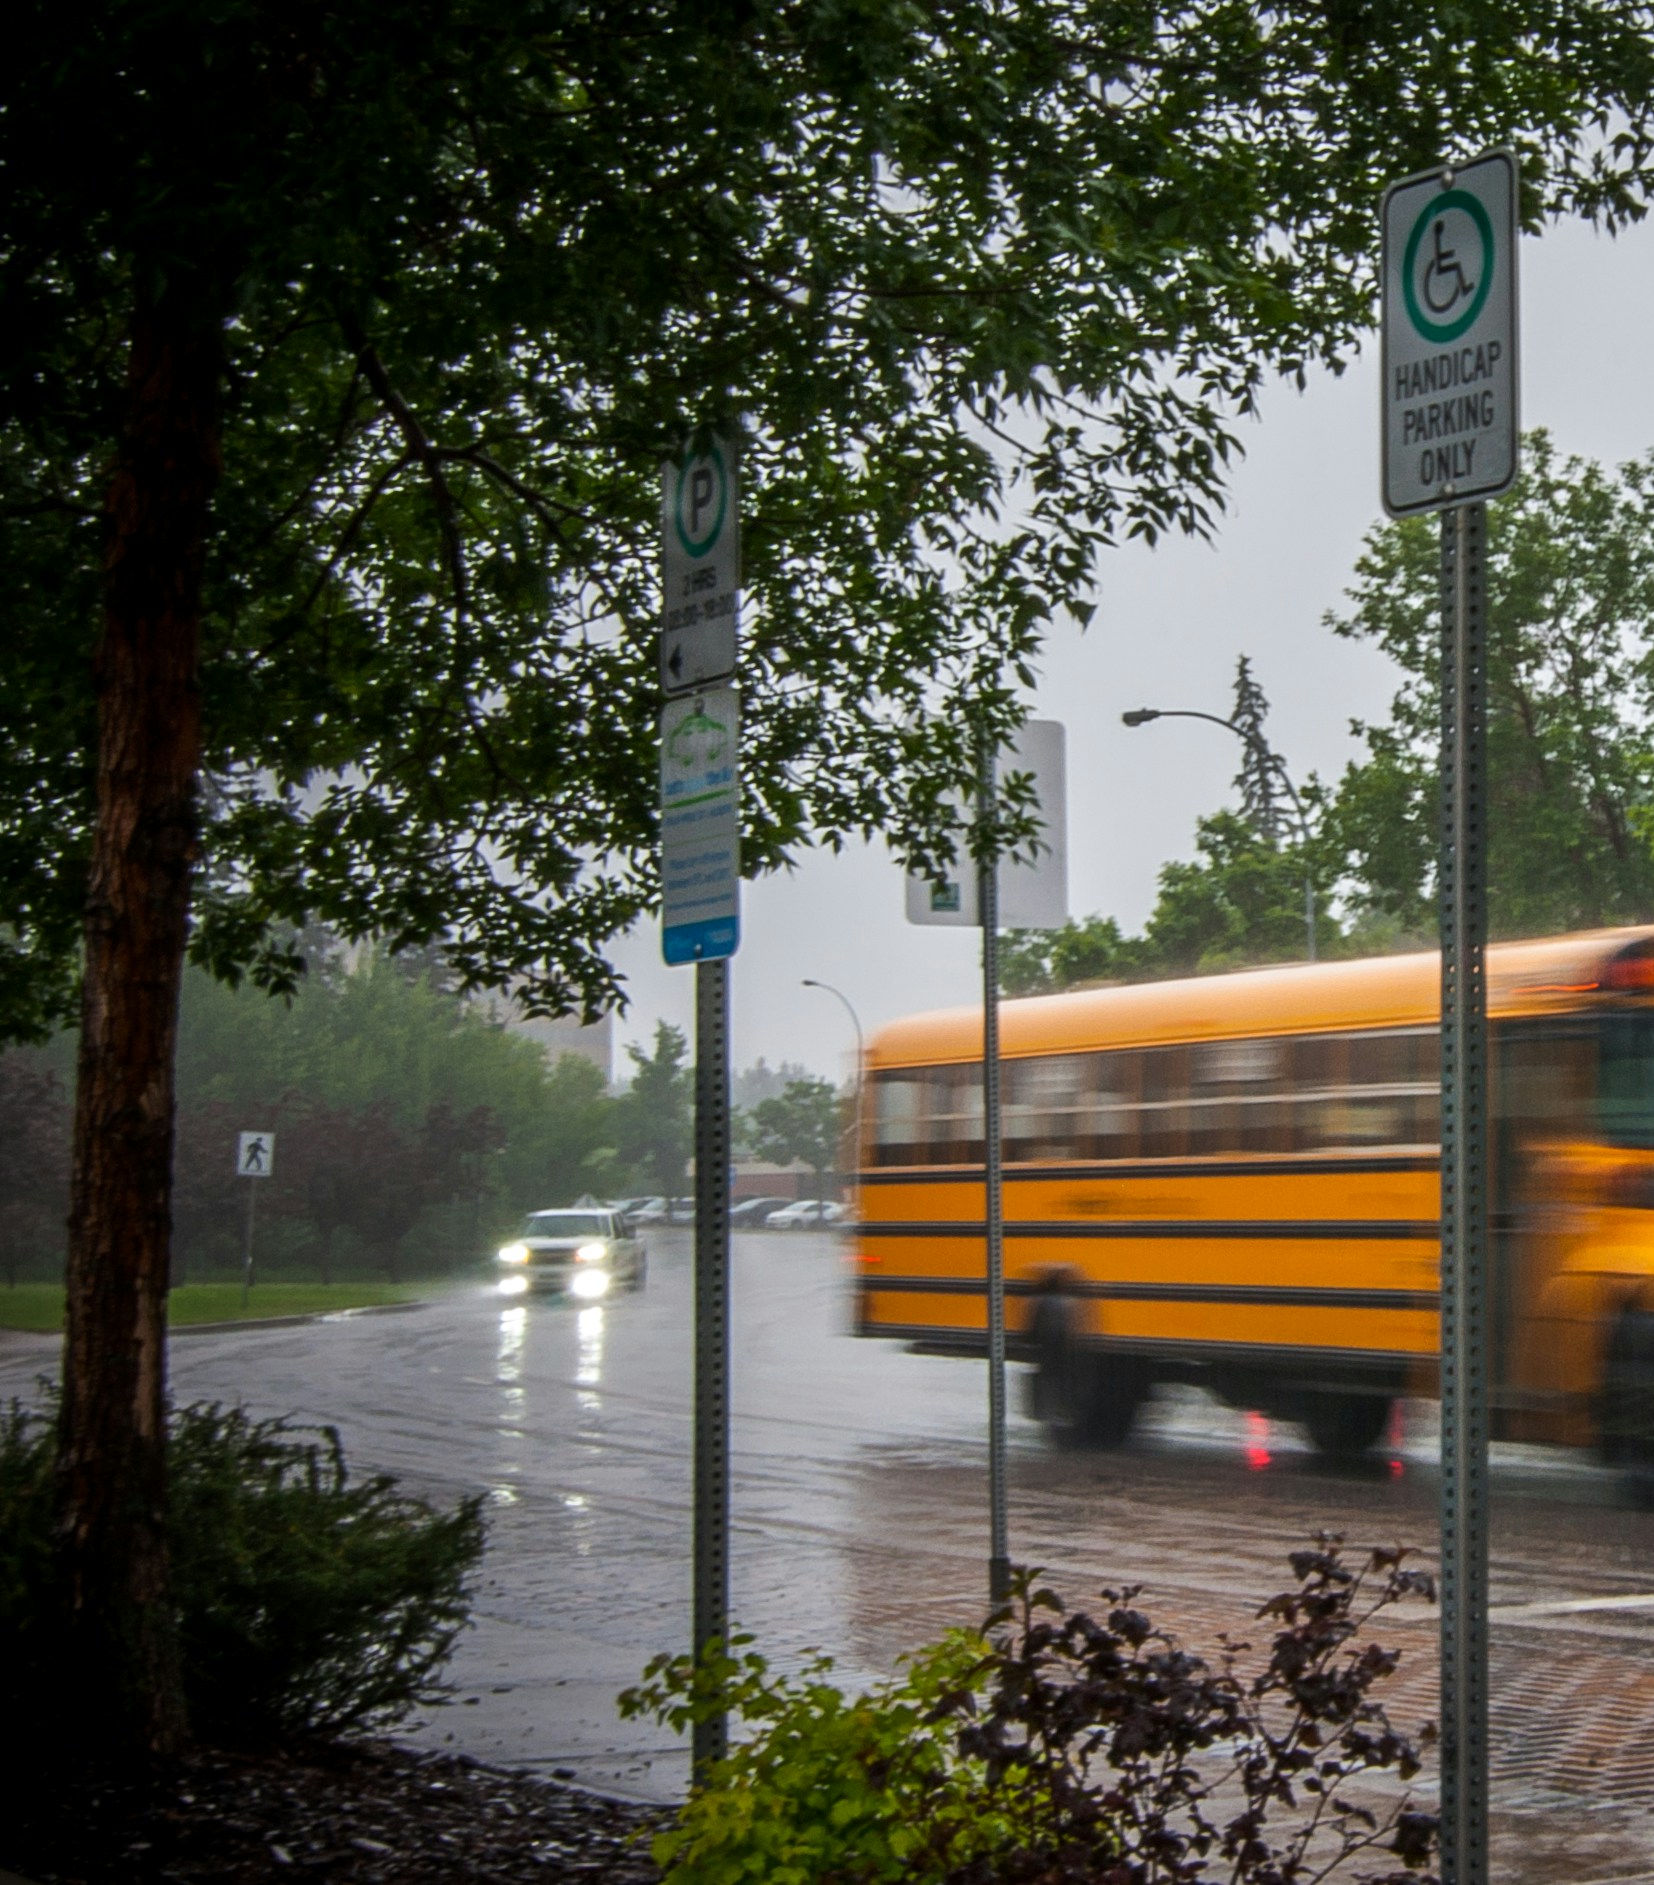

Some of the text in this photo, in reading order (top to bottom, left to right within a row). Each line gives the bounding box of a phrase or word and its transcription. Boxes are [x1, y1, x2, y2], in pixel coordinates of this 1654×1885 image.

[1395, 340, 1501, 401] HANDICAP
[1403, 390, 1494, 446] PARKING
[1421, 438, 1476, 486] ONLY
[691, 467, 713, 533] P
